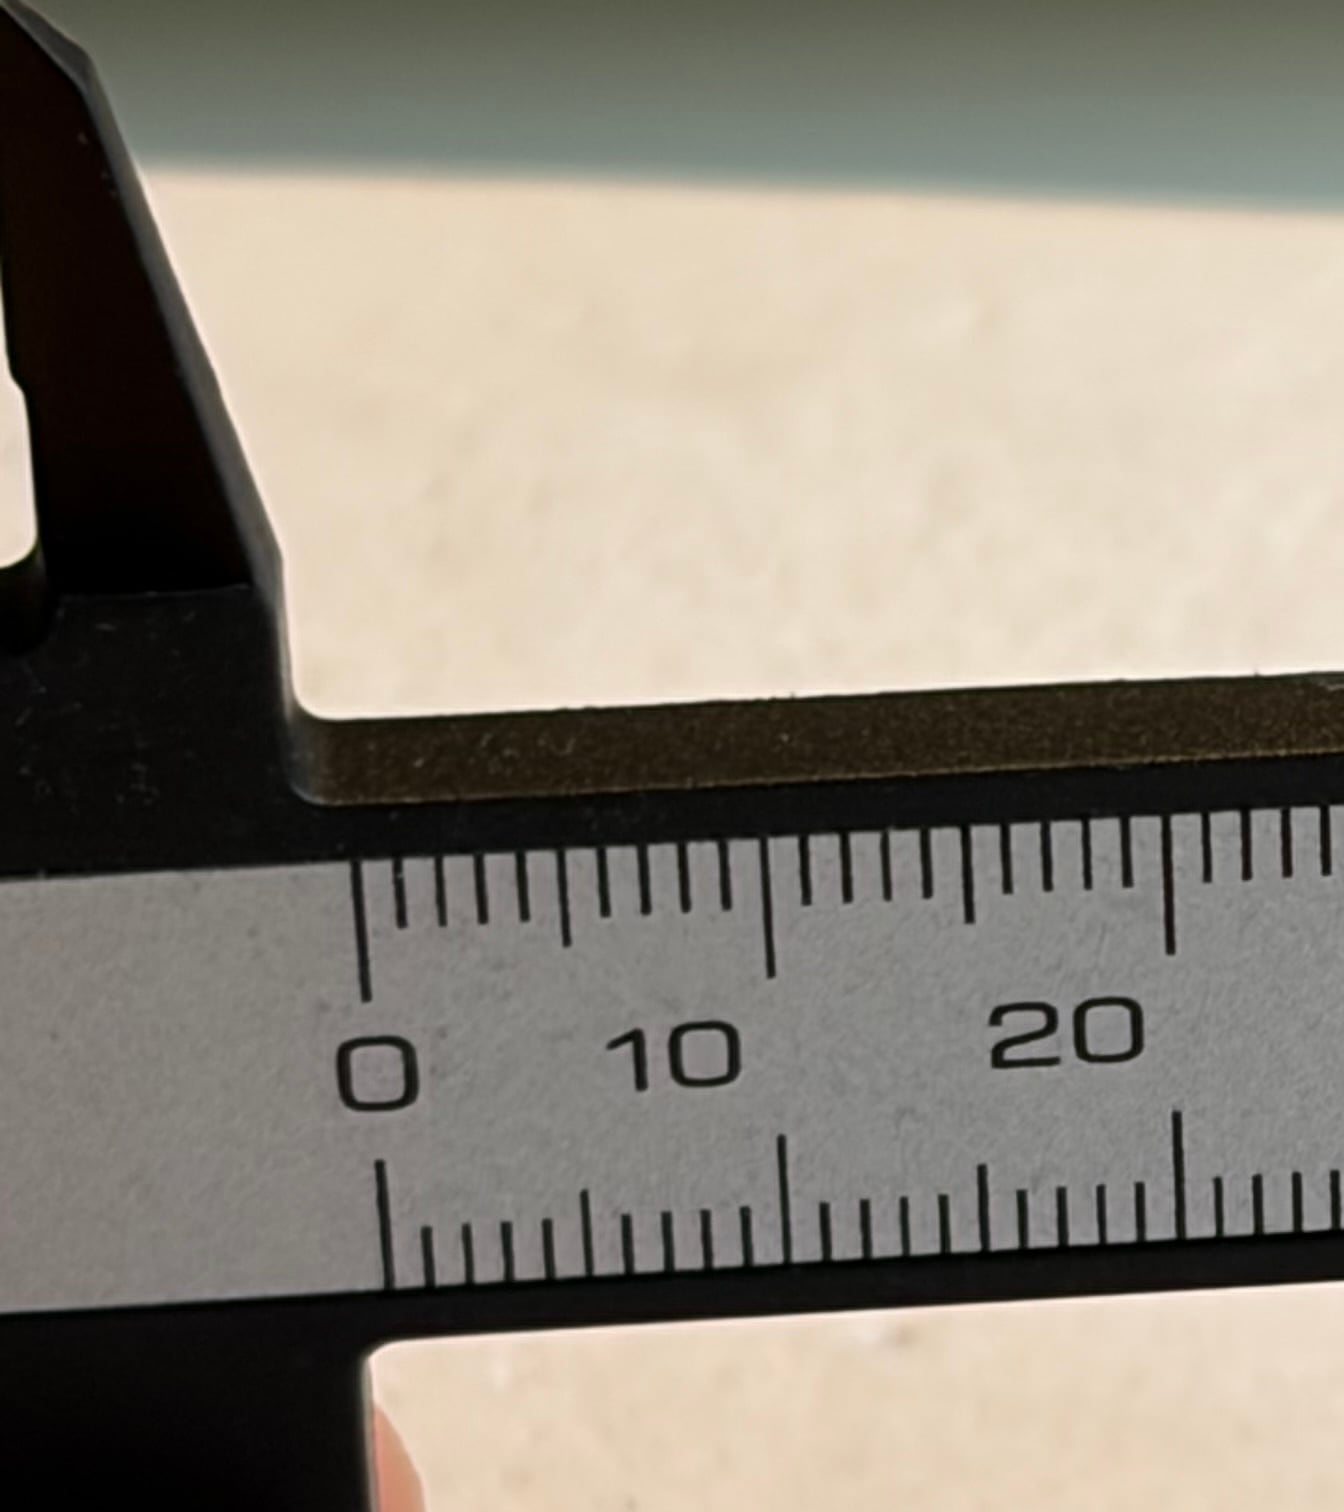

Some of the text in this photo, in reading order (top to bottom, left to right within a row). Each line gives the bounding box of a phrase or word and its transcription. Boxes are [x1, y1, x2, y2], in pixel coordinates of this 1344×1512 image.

[335, 1034, 421, 1112] 0
[604, 1019, 743, 1094] 10
[987, 995, 1146, 1070] 20
